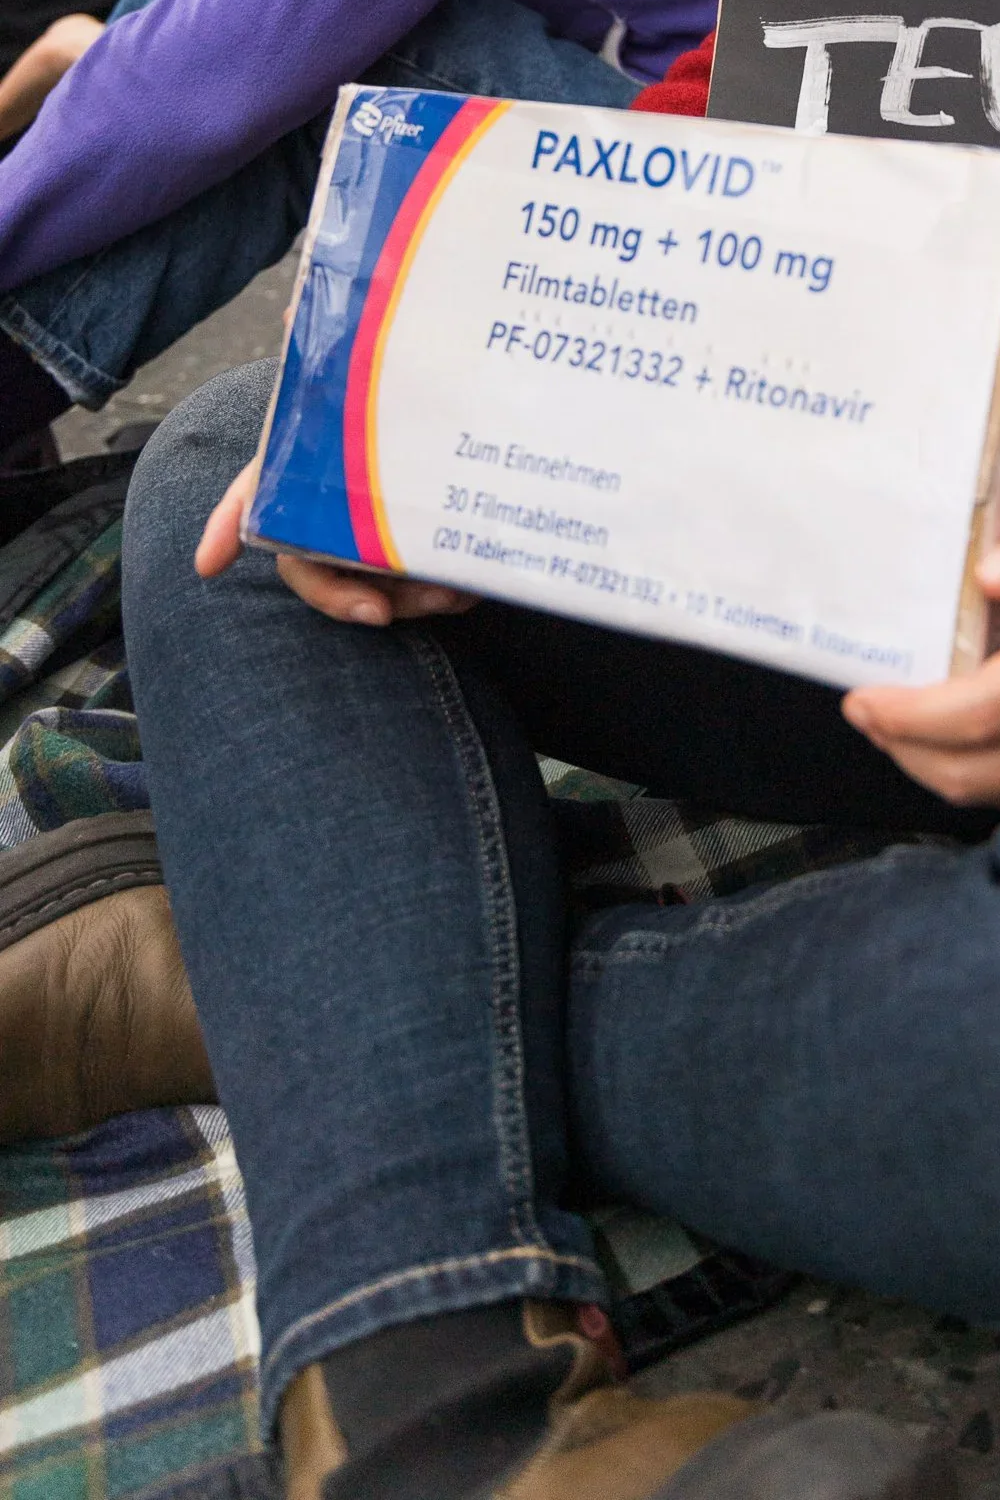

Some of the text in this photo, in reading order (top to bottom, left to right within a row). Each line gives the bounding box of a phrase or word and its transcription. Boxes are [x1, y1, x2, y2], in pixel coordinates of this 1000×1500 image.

[521, 200, 834, 294] 150 mg + 100 mg
[502, 260, 699, 324] Filmtabletten
[486, 321, 875, 425] PF-07321332 + Ritonavir
[454, 431, 623, 494] Zum Einnehmen
[442, 484, 610, 548] 30 Filmtabletten
